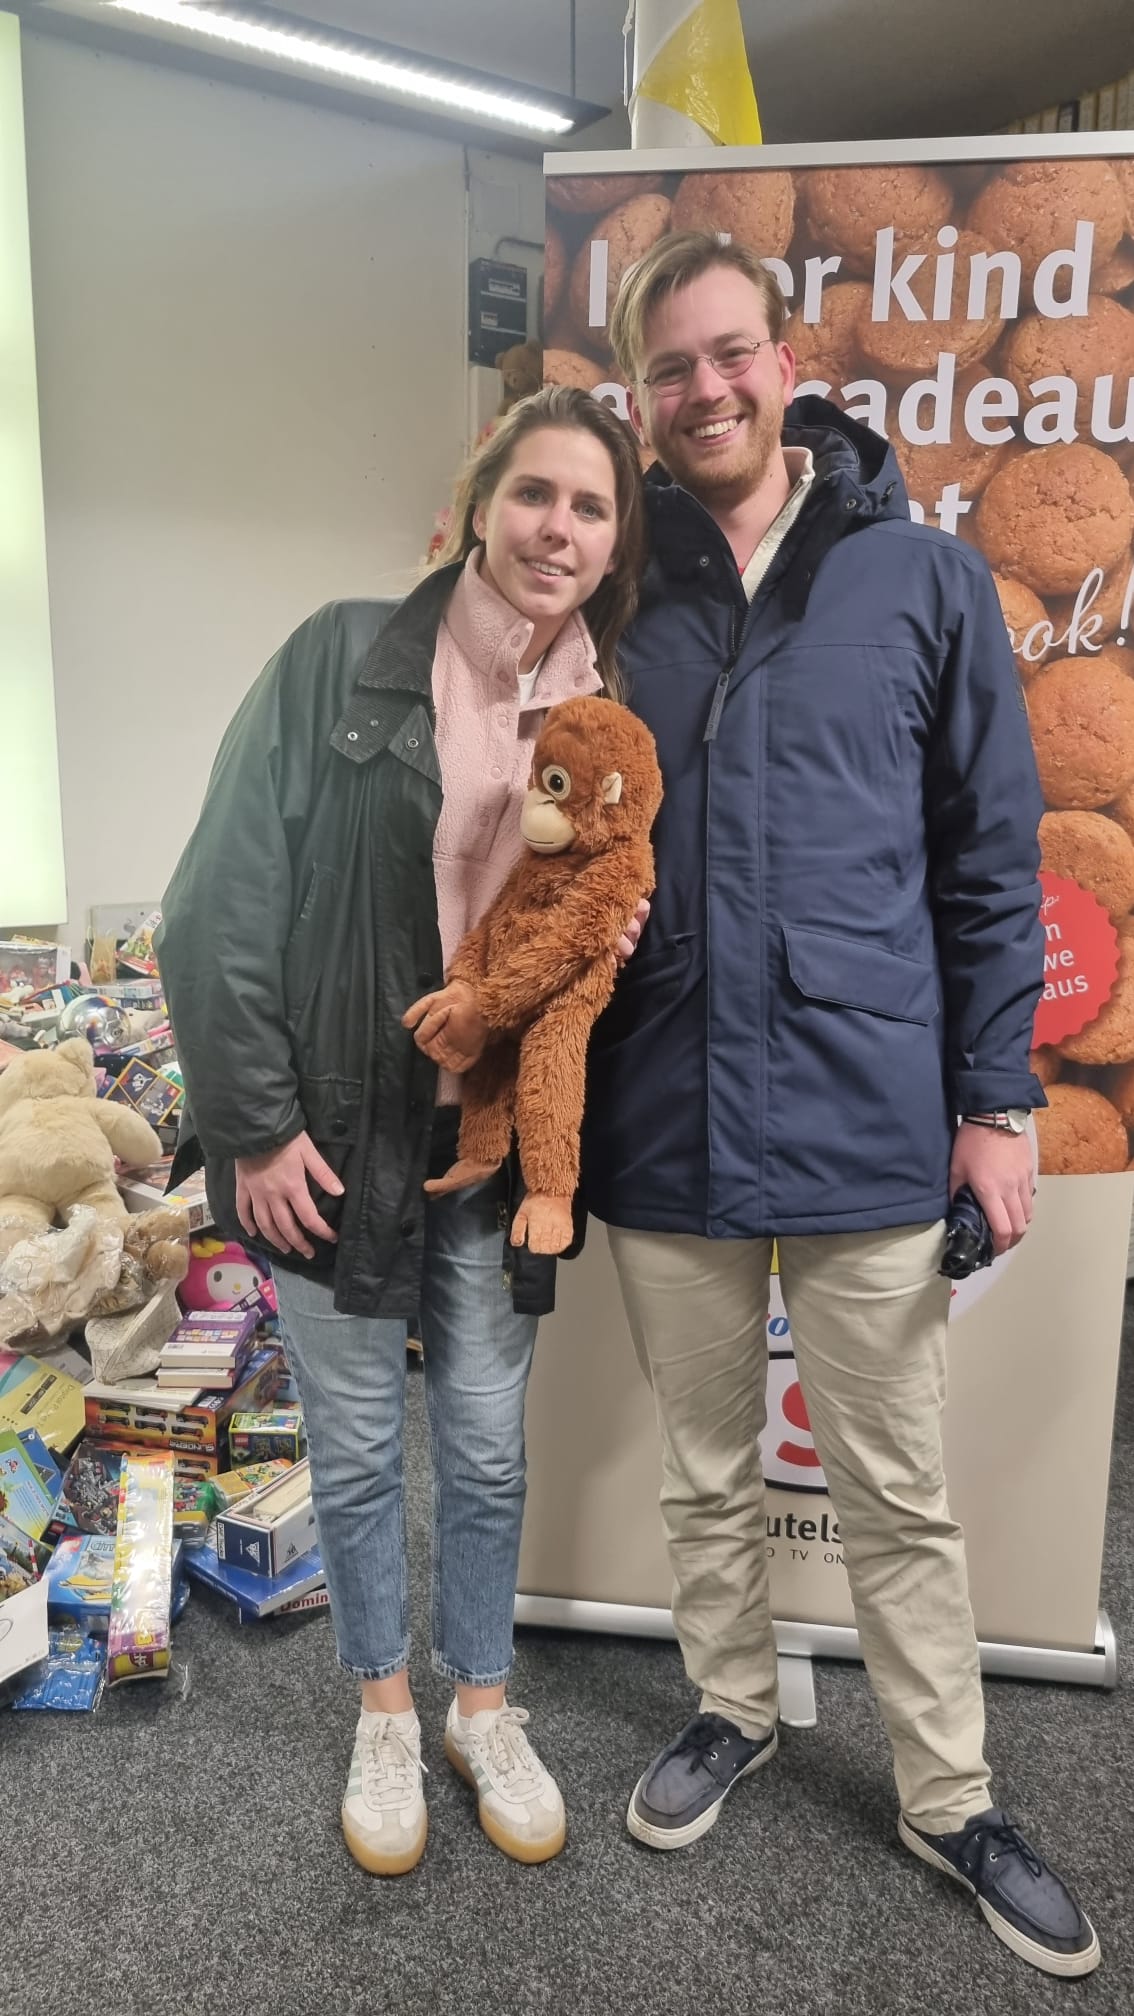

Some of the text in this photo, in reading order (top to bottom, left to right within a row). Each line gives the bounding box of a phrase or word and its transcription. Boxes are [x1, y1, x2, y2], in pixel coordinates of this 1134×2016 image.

[871, 219, 1095, 324] kind
[1043, 949, 1076, 972] we
[1039, 974, 1090, 1002] aus
[790, 1549, 809, 1561] TV
[823, 1552, 846, 1565] ON
[281, 1594, 328, 1612] Domin
